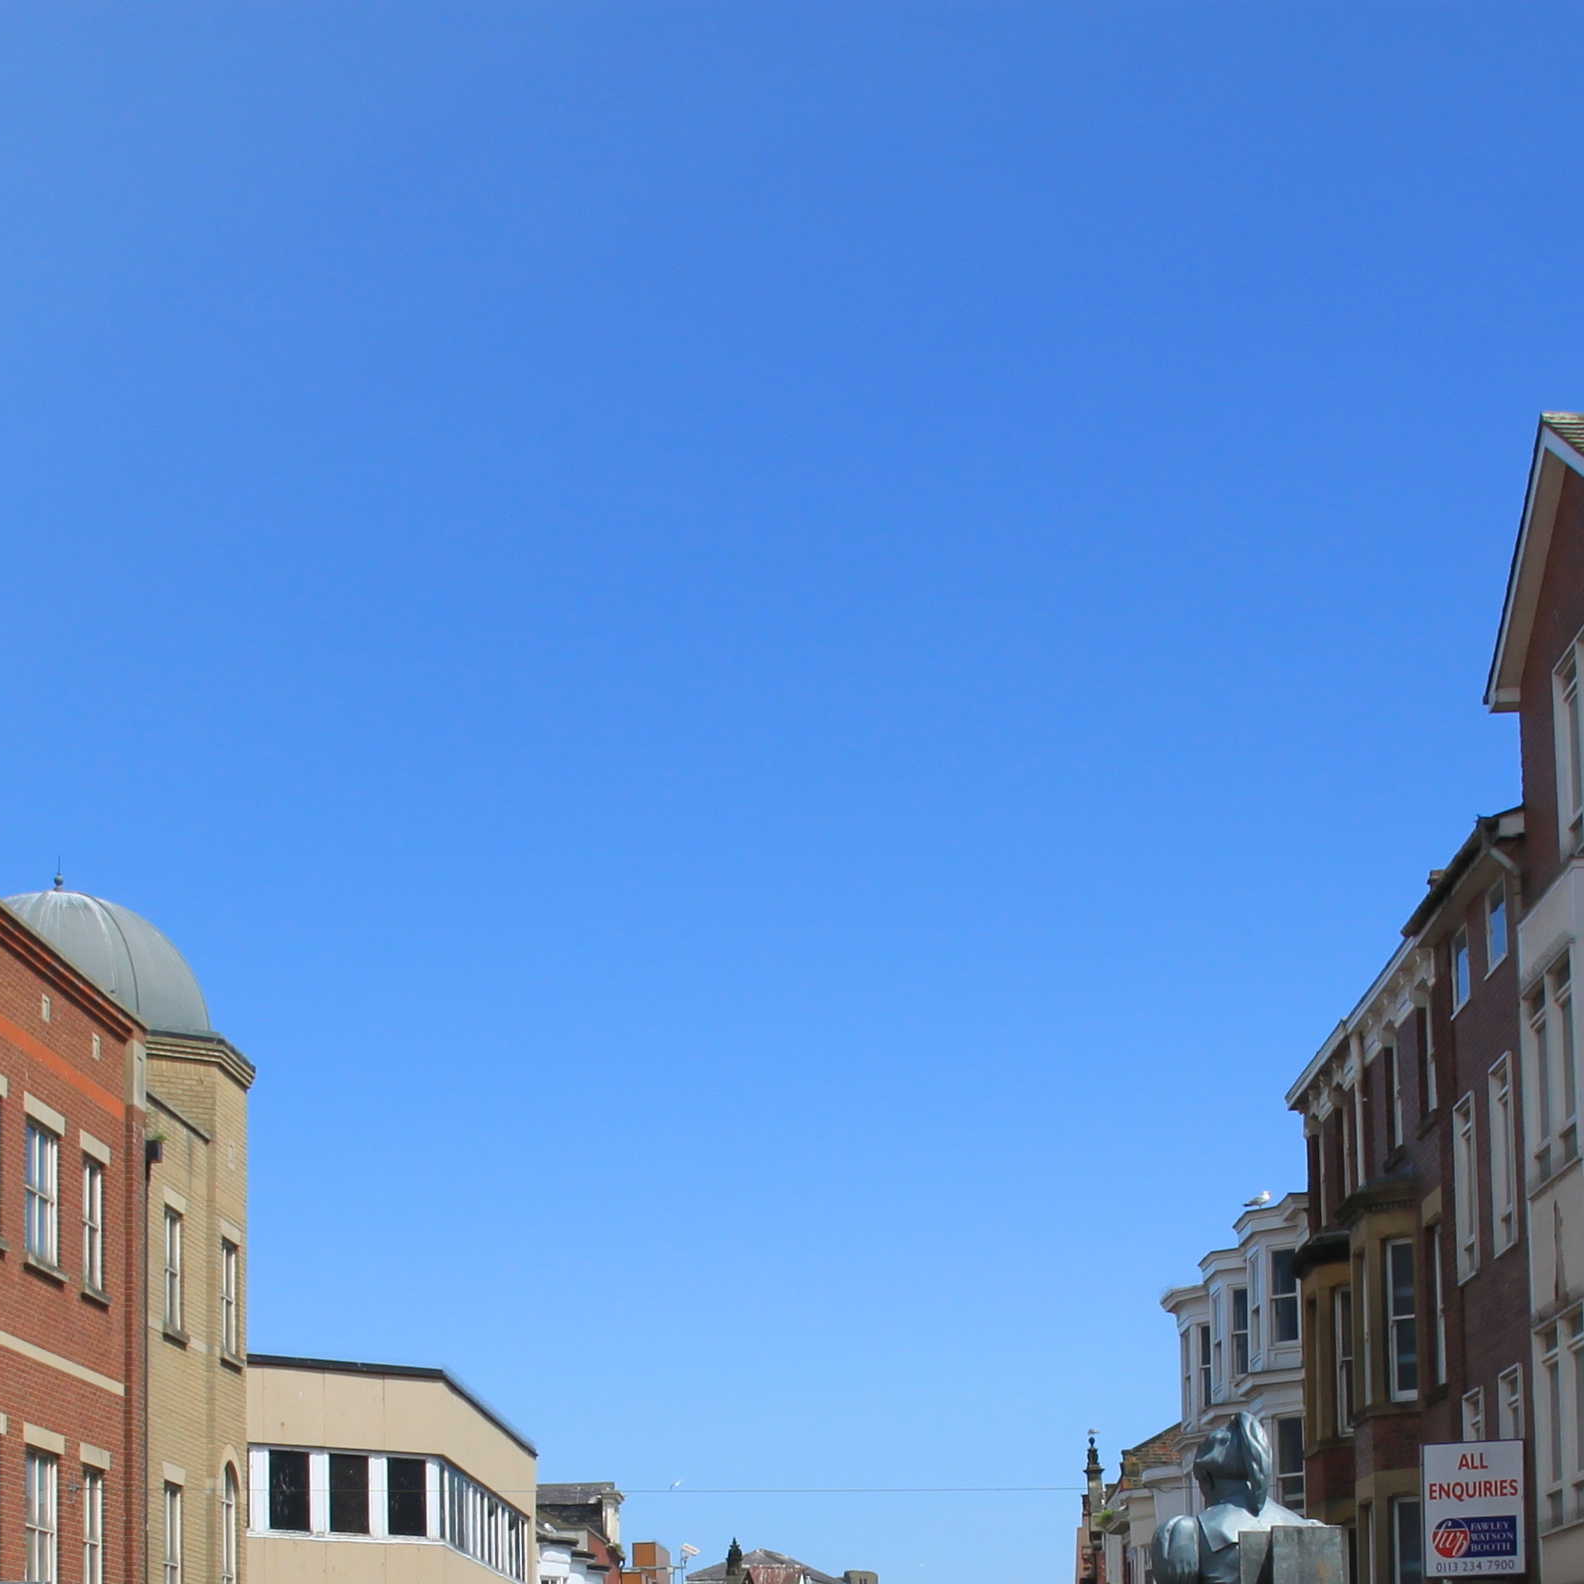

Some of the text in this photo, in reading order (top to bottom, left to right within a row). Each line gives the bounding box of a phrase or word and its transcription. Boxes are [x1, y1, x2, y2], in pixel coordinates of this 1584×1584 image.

[1457, 1453, 1488, 1470] ALL
[1429, 1479, 1518, 1502] ENQUIRIES
[1470, 1522, 1510, 1531] FAWLEY
[1471, 1531, 1514, 1541] WATSON
[1471, 1542, 1510, 1552] BOOTH
[1436, 1559, 1514, 1572] 0113 234 7900
